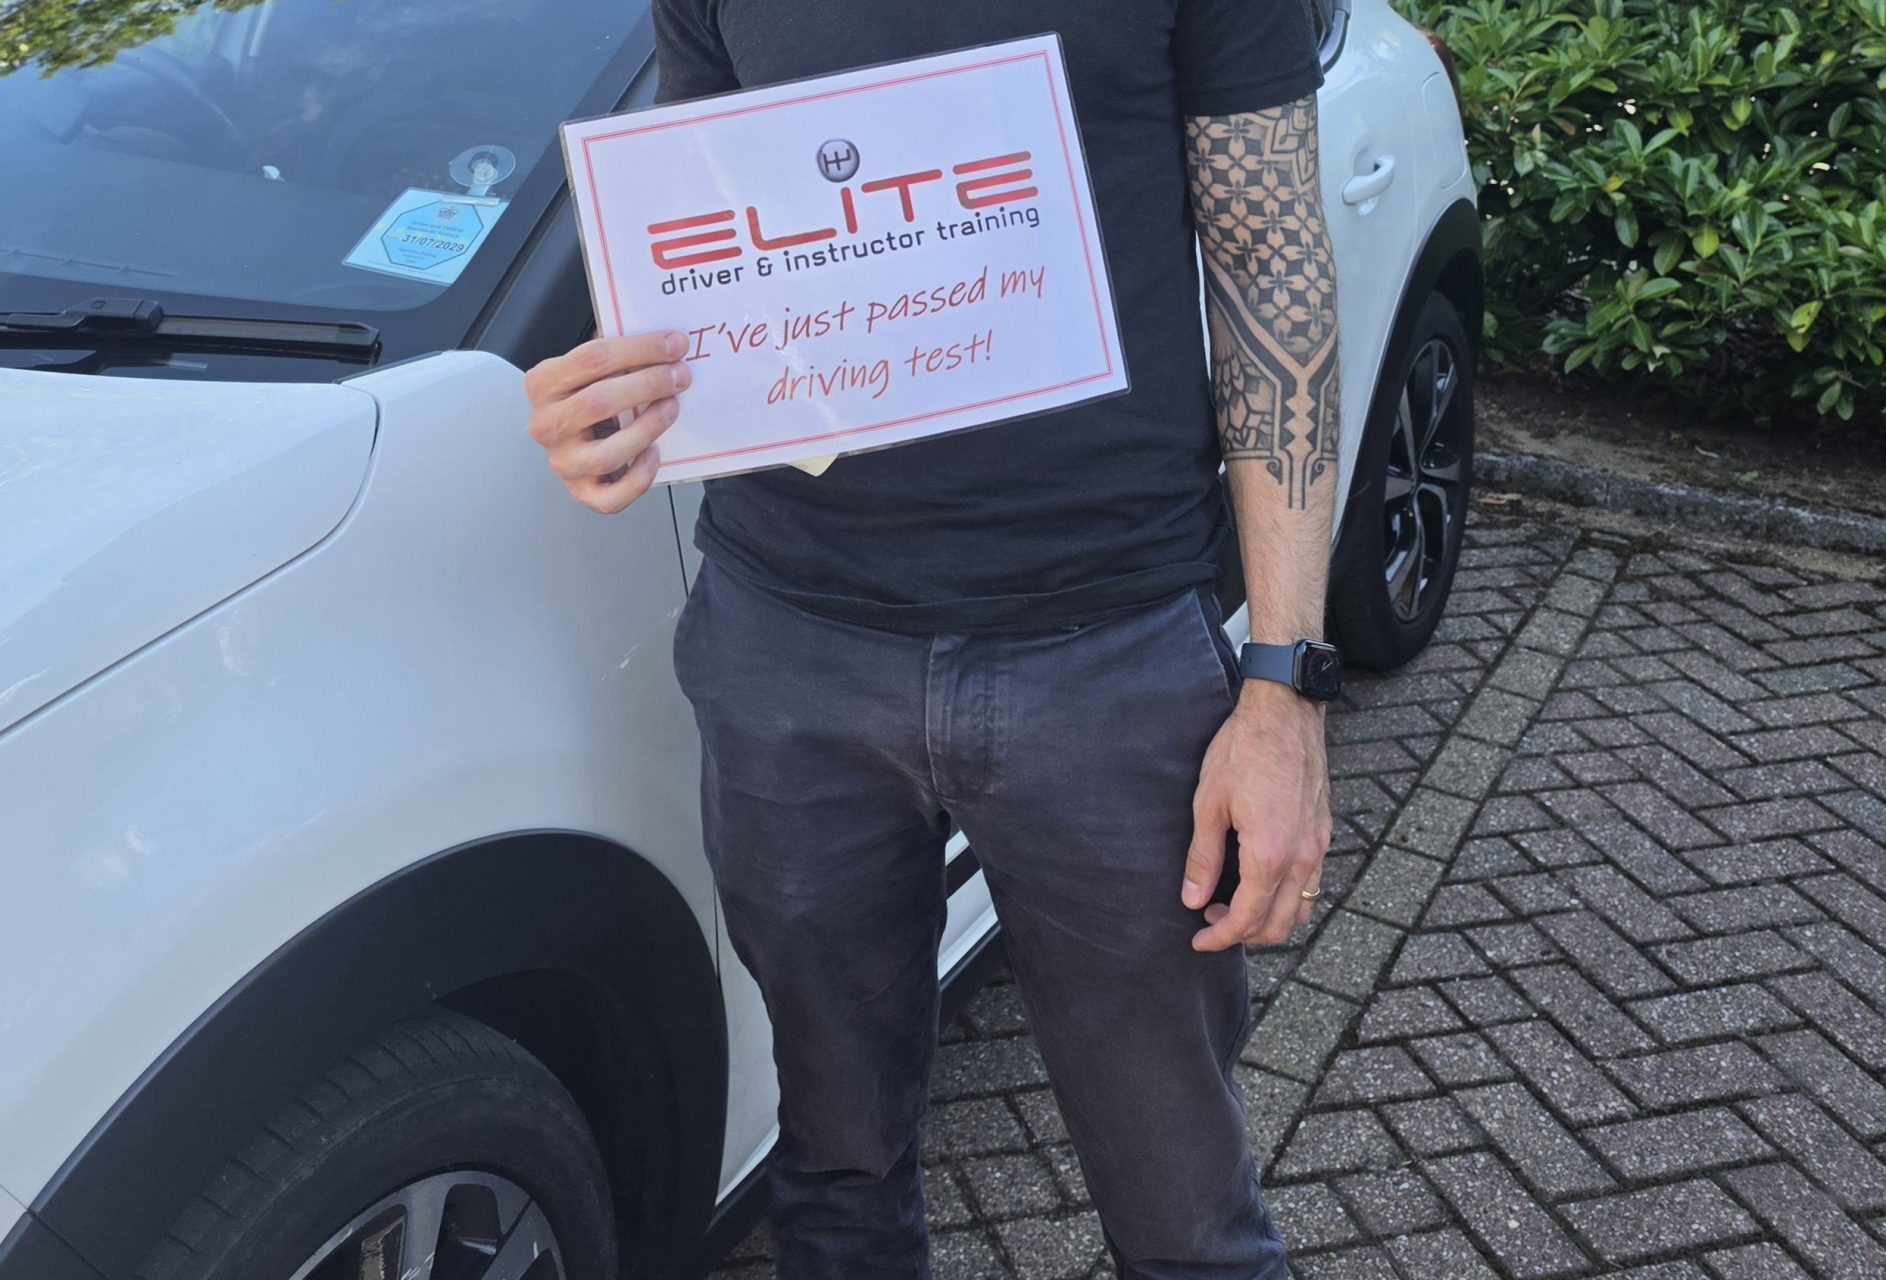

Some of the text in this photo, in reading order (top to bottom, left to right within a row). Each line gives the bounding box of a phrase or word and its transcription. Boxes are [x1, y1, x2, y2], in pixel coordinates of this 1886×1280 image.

[661, 206, 1041, 296] driver & instructor training
[685, 265, 1045, 362] I've just passed my
[767, 329, 993, 405] driving test!
